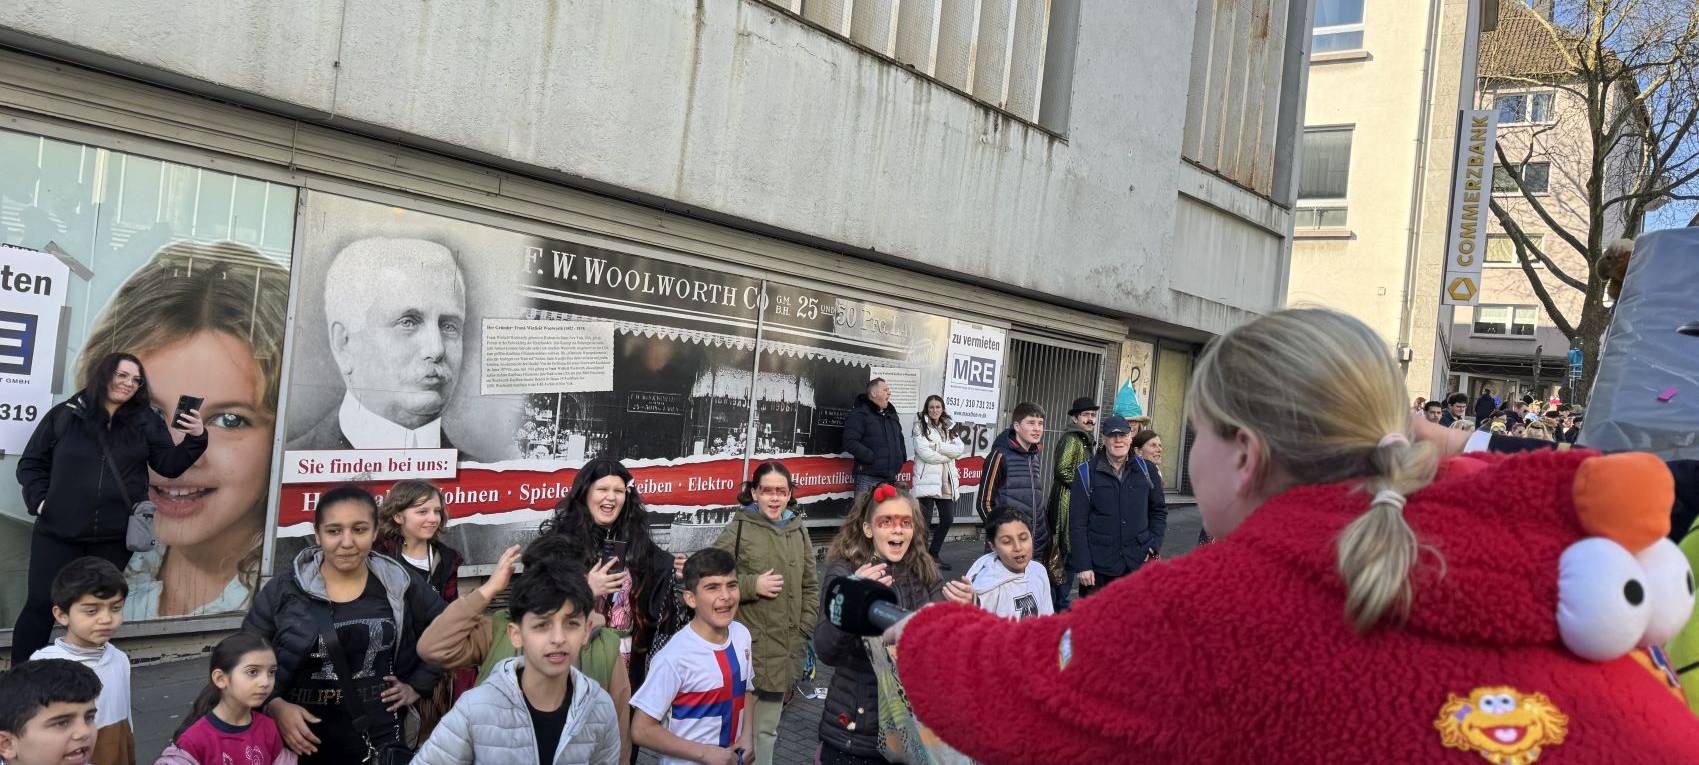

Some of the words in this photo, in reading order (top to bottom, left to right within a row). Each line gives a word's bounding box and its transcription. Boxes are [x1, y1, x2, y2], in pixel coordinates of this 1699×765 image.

[1457, 115, 1489, 267] COMMERZBANK
[522, 246, 543, 275] F.
[552, 250, 578, 280] W.
[584, 256, 737, 308] WOOLWORTH
[796, 295, 818, 320] 25
[836, 304, 857, 328] 50
[952, 333, 962, 345] zu
[963, 335, 1000, 351] vermieten
[953, 358, 995, 384] MRE
[298, 458, 325, 474] Sie
[329, 458, 382, 474] finden
[388, 457, 412, 472] bei
[417, 459, 449, 471] uns:
[442, 486, 499, 505] ohnen
[519, 483, 572, 505] Spiele
[636, 478, 673, 494] eiben
[688, 476, 734, 492] Elektro
